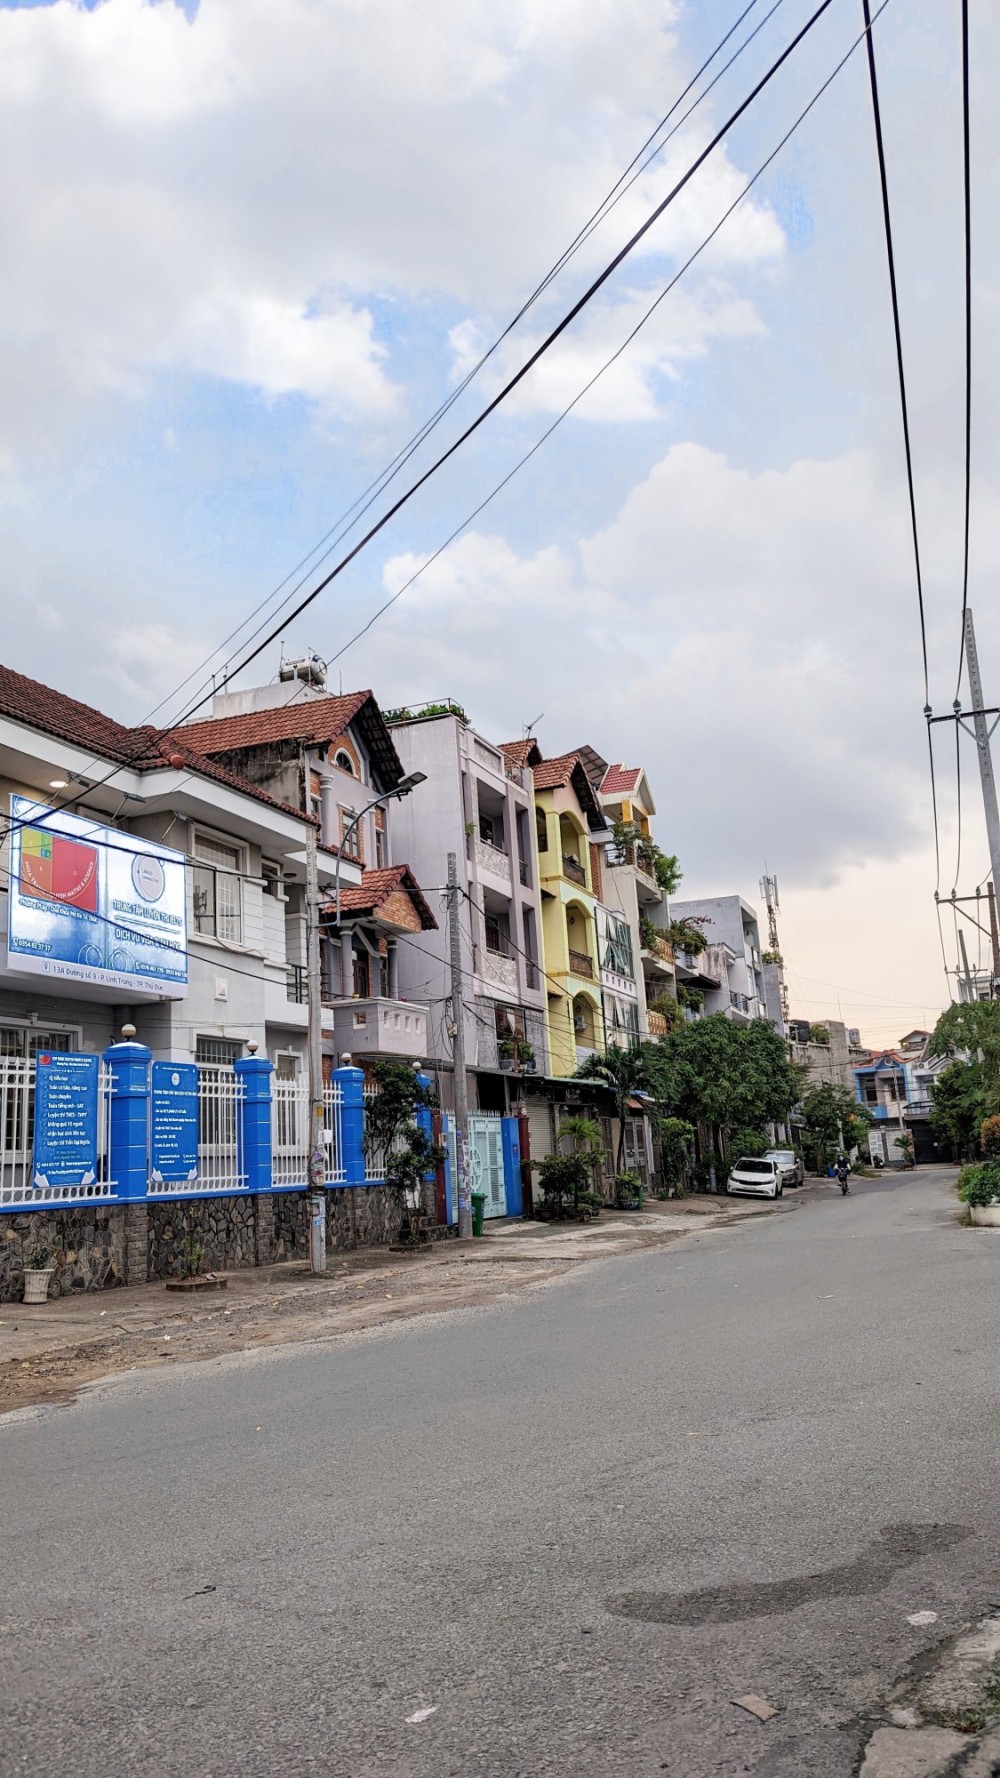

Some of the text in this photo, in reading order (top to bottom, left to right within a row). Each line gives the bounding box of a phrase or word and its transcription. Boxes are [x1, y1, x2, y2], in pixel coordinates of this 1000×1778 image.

[113, 900, 132, 913] TRUNG
[132, 904, 143, 916] TÂM
[115, 928, 131, 942] DỊCH
[66, 968, 85, 979] Đường
[85, 971, 92, 979] số
[106, 976, 117, 984] Linh
[117, 978, 132, 987] Trung
[145, 982, 155, 990] Thủ
